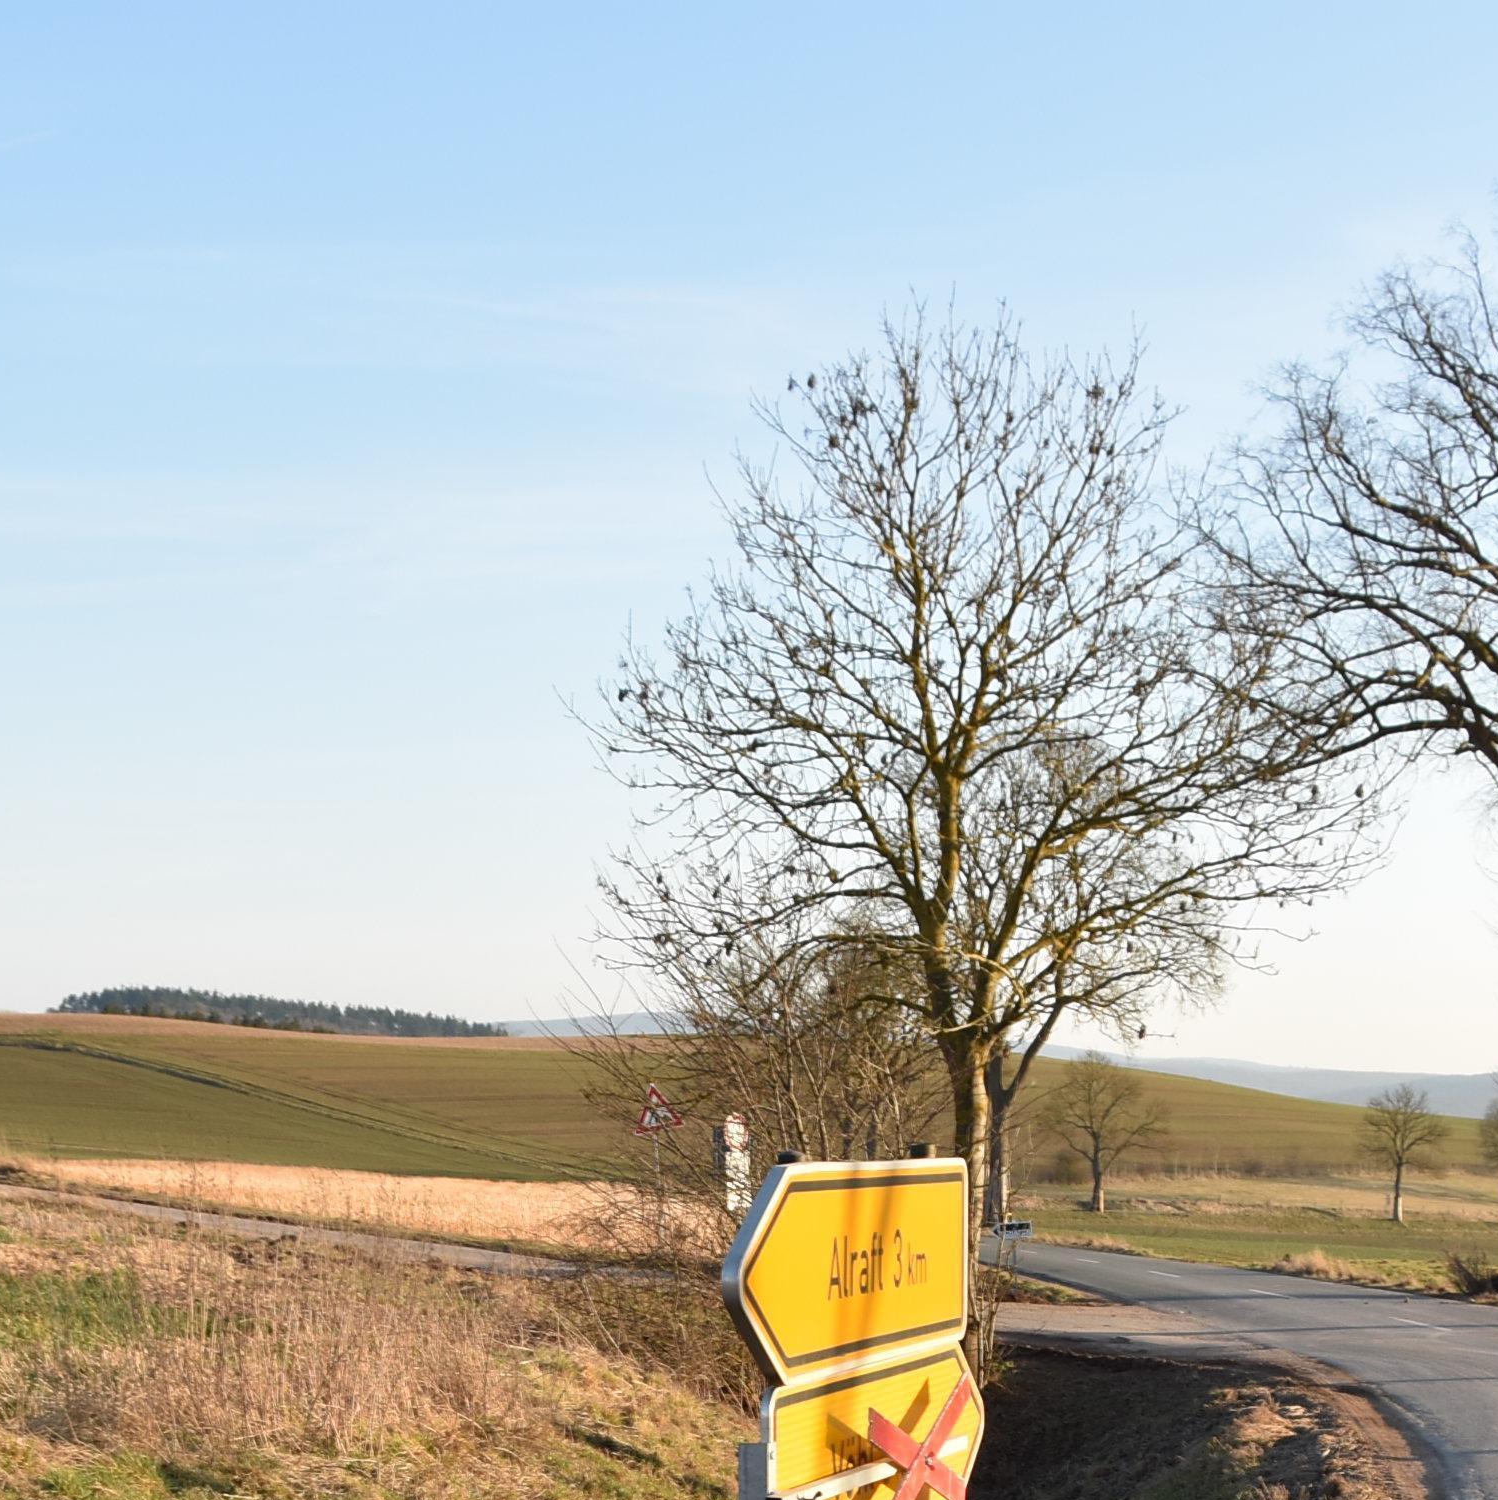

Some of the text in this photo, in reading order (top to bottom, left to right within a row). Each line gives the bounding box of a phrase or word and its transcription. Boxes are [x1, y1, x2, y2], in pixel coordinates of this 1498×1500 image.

[827, 1229, 928, 1301] Alraft 3 km
